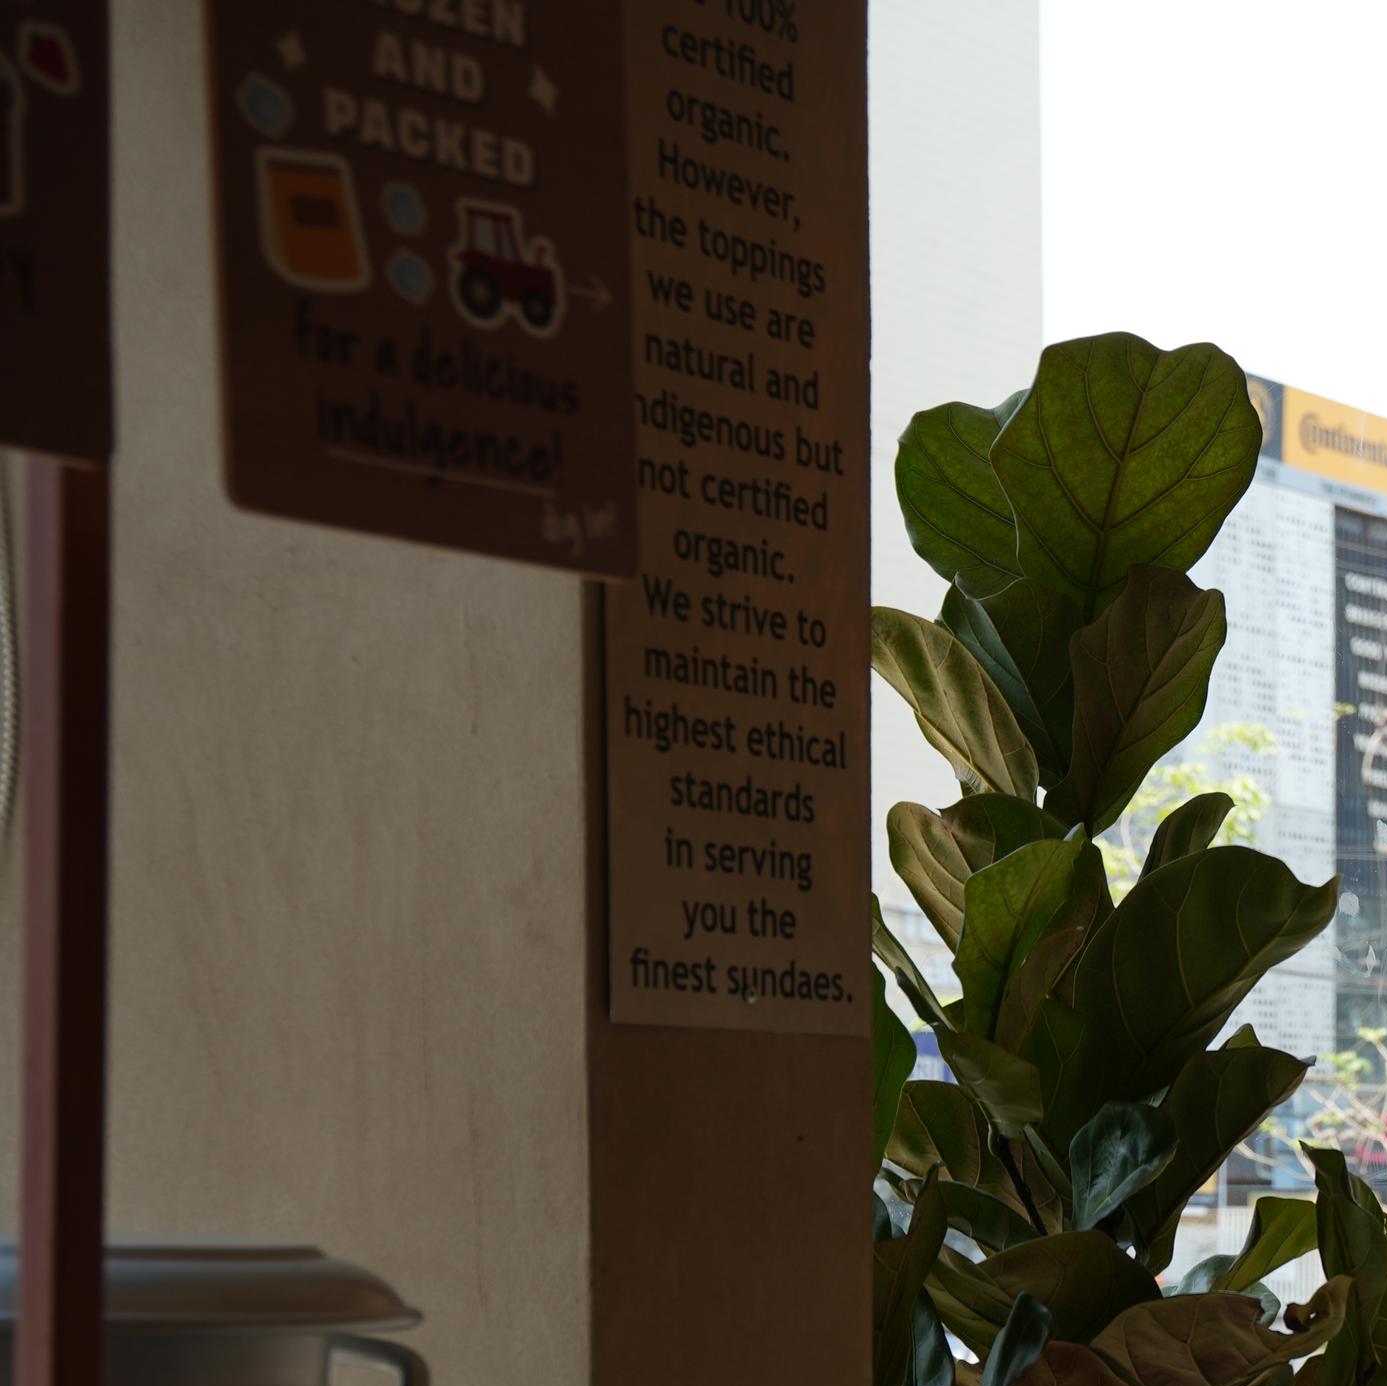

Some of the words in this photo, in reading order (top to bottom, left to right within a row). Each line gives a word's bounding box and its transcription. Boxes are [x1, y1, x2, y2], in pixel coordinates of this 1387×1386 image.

[323, 85, 535, 186] PACKED
[642, 572, 691, 622] We
[701, 593, 787, 640] strive
[797, 609, 827, 649] to
[643, 645, 778, 700] maintain
[789, 665, 837, 710] the
[624, 695, 736, 754] highest
[747, 721, 847, 770] ethical
[630, 947, 717, 995] finest
[727, 958, 853, 1003] sundaes.
